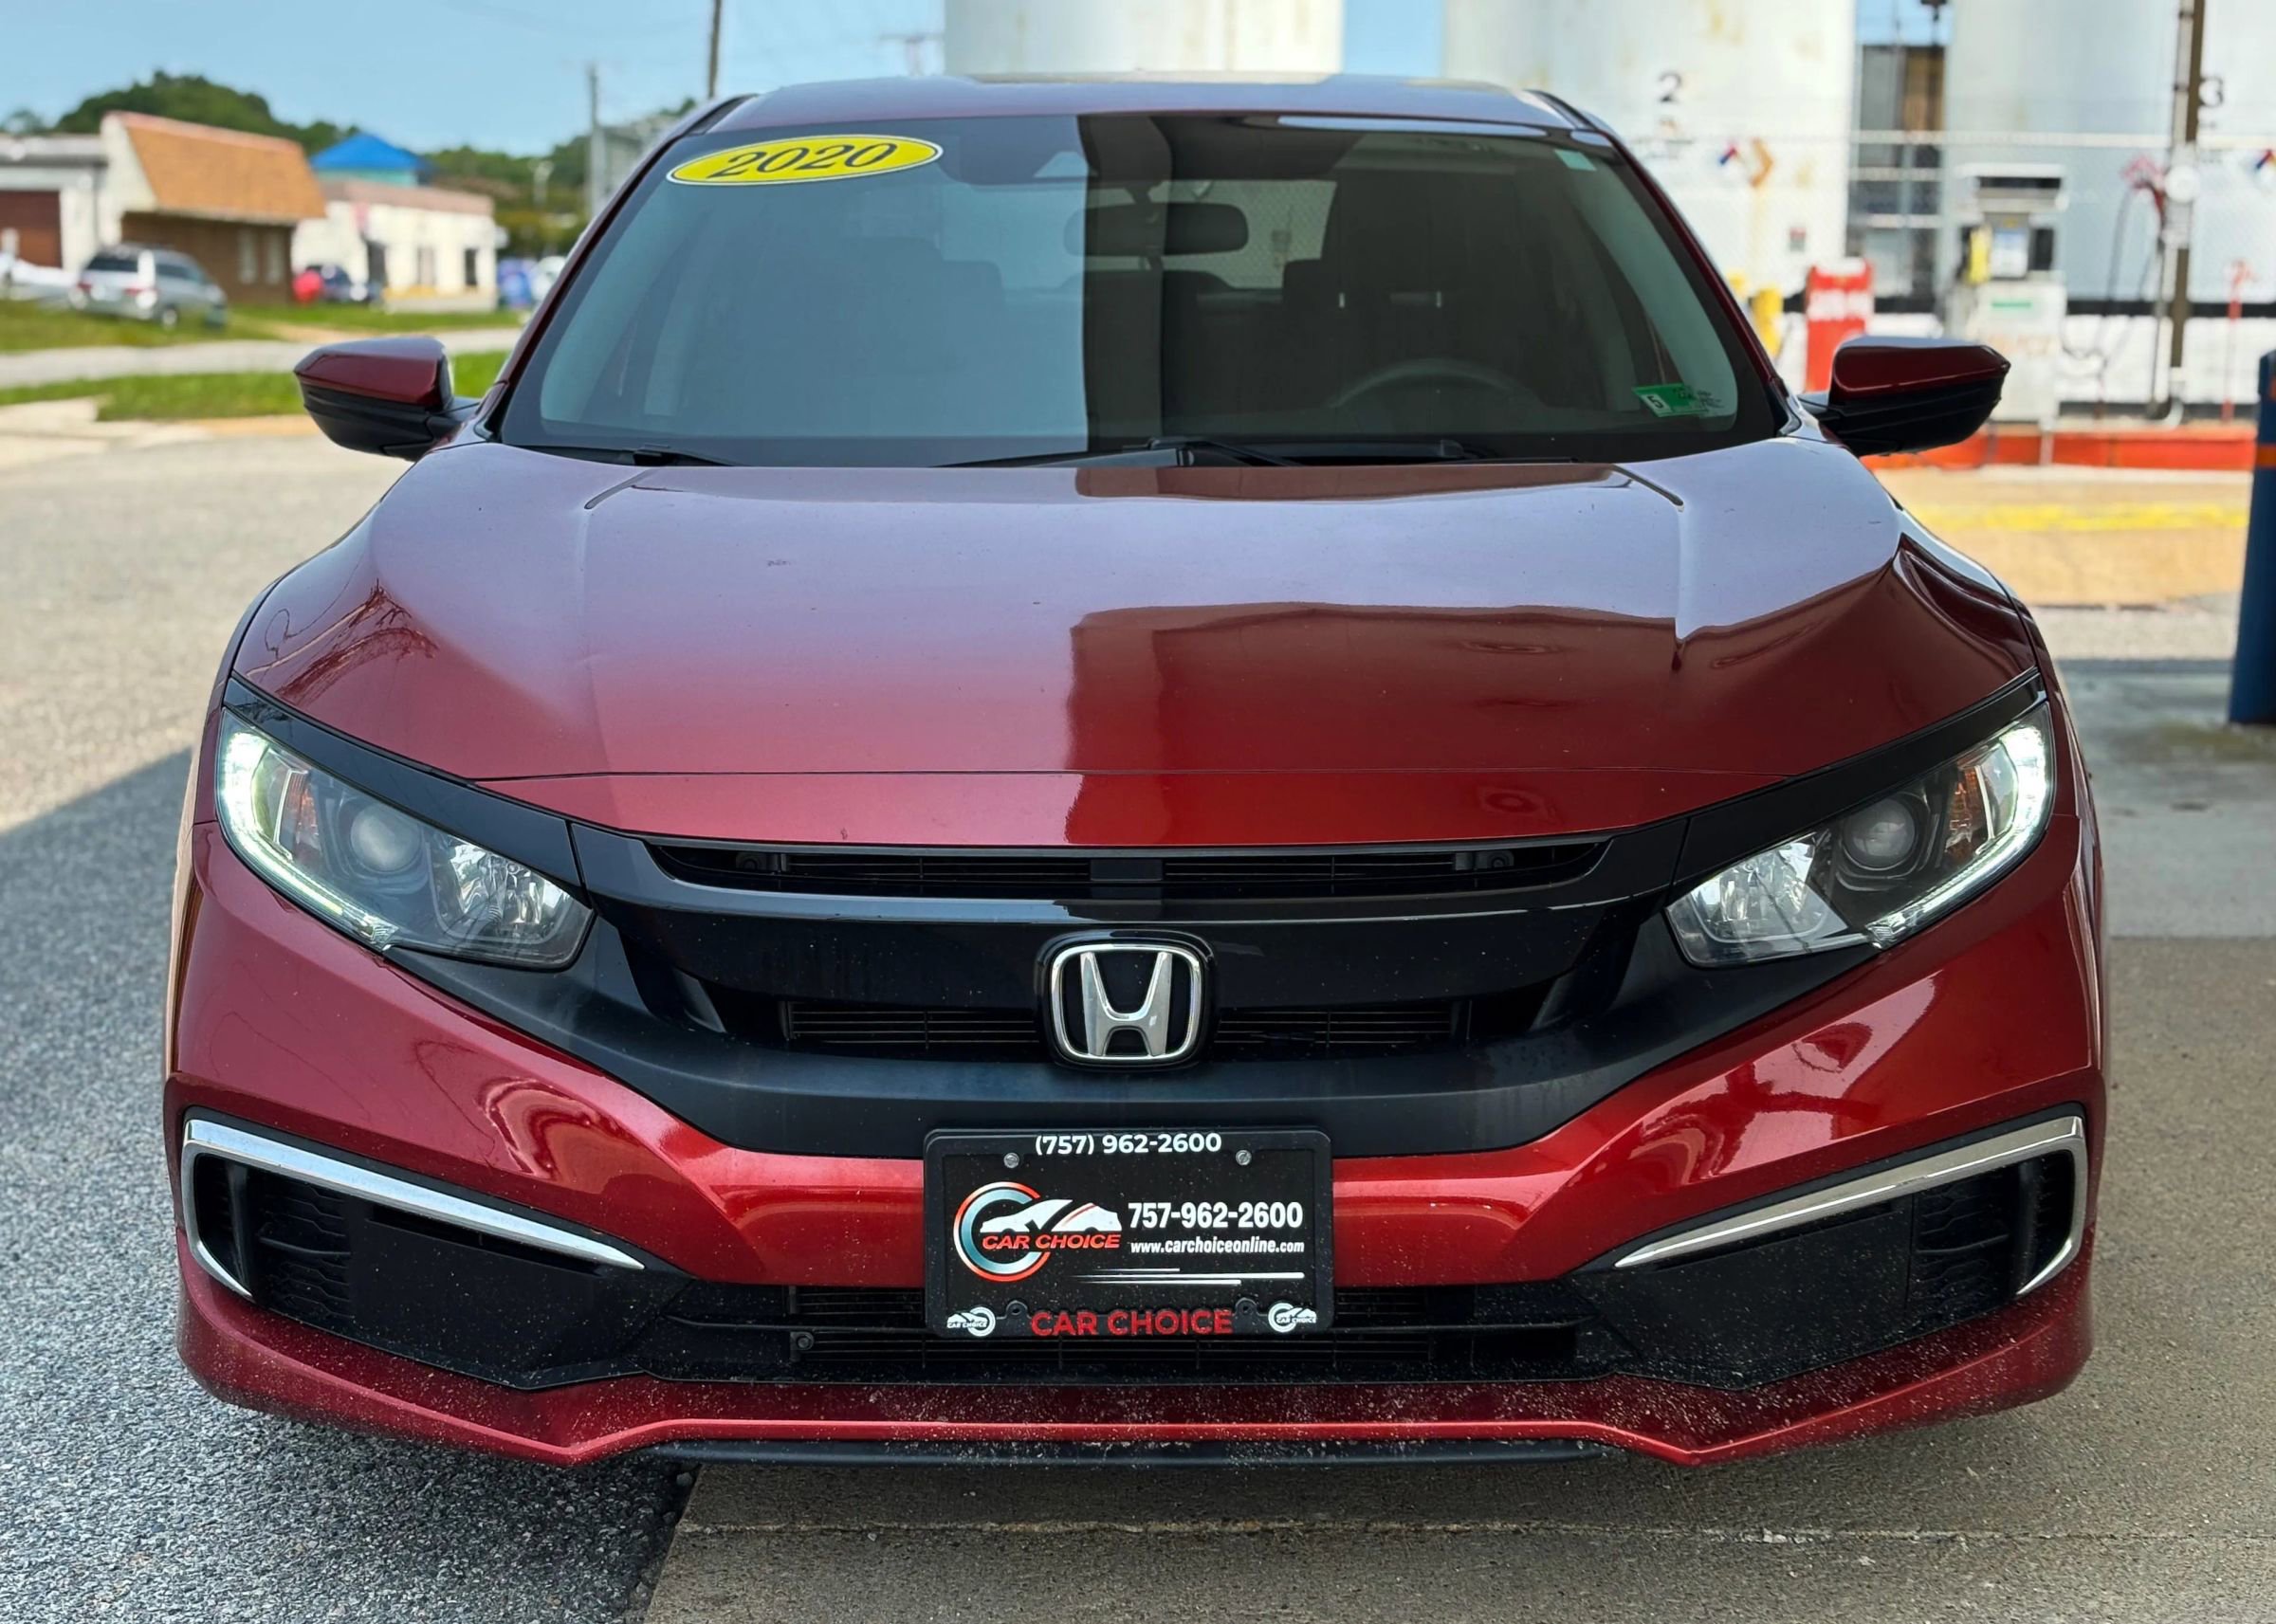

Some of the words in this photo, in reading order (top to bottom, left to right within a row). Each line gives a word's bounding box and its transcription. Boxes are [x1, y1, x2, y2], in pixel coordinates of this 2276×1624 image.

[1659, 72, 1682, 102] 2
[706, 142, 898, 178] 2020
[1035, 1134, 1094, 1155] (757)
[1102, 1133, 1221, 1154] 962-2600
[1128, 1201, 1304, 1229] 757-962-2600
[982, 1234, 1030, 1250] CAR
[1035, 1233, 1121, 1249] CHOICE
[1130, 1236, 1305, 1253] www.carchoiceonline.com
[1031, 1310, 1098, 1336] CAR
[1109, 1308, 1232, 1335] CHOICE
